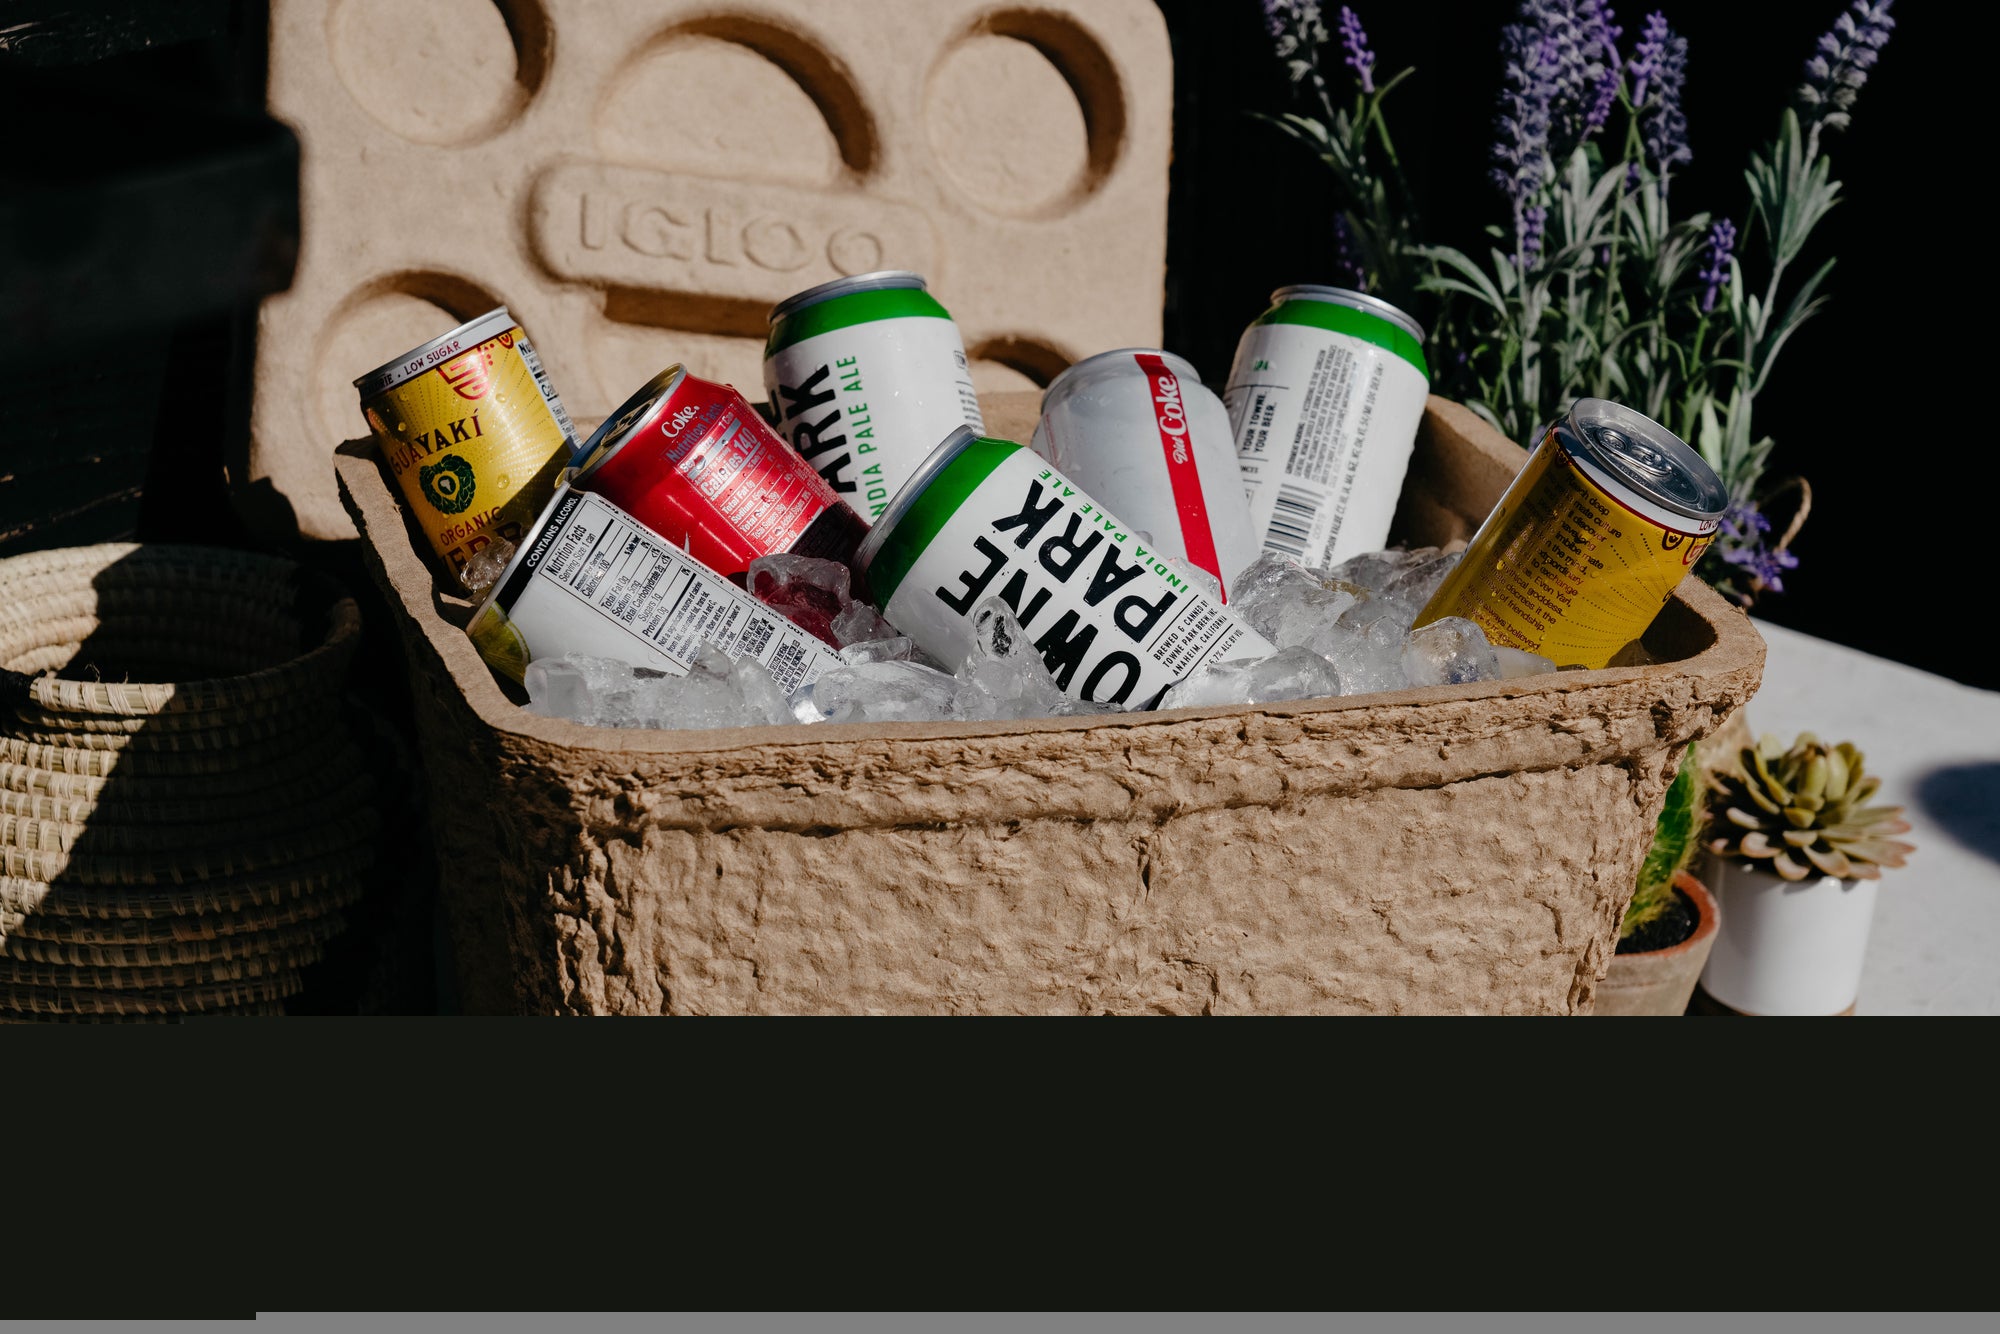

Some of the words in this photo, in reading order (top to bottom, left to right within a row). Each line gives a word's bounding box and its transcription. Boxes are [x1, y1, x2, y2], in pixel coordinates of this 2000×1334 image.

[579, 192, 884, 277] IGLOO
[402, 357, 426, 375] LOW
[426, 341, 460, 363] SUGAR
[836, 356, 863, 392] ALE
[390, 408, 484, 475] GUAYAKÍ
[666, 423, 705, 461] Nutrition
[699, 403, 722, 423] Facts
[778, 363, 857, 492] ARK
[848, 403, 878, 454] PALE
[1242, 428, 1254, 450] YOUR
[1254, 430, 1267, 451] YOUR
[701, 454, 745, 495] Calories
[728, 428, 759, 455] 140
[1173, 436, 1188, 465] Diet
[722, 495, 739, 513] Total
[736, 486, 748, 498] Fat
[862, 463, 889, 527] NDIA
[1038, 468, 1075, 498] ALE
[598, 499, 618, 514] free
[731, 498, 754, 523] Sodium
[740, 514, 757, 531] Total
[761, 511, 780, 528] Sugars
[1079, 502, 1128, 543] PALE
[1571, 498, 1595, 519] mate
[1587, 494, 1613, 517] deep
[440, 506, 504, 547] ORGANIC
[527, 525, 558, 566] CONTAINS
[555, 498, 577, 524] ALCOHOL
[623, 515, 655, 537] gluten
[1571, 513, 1608, 544] discover
[545, 543, 574, 575] Nutrition
[566, 524, 586, 544] Facts
[558, 559, 579, 582] Serving
[573, 547, 586, 560] Size
[585, 533, 595, 543] can
[598, 558, 610, 571] 100
[992, 478, 1178, 644] PARK
[1549, 544, 1566, 559] the
[1553, 530, 1584, 556] imbibe
[1580, 549, 1605, 571] mate
[574, 573, 587, 590] Amount
[589, 551, 605, 565] Serving
[1135, 545, 1189, 593] INDIA
[1529, 558, 1541, 570] to
[1537, 564, 1580, 598] exchange
[1532, 575, 1557, 596] Even
[600, 593, 615, 609] Total
[611, 582, 623, 594] Fat
[618, 574, 631, 586] 0g
[611, 593, 630, 616] Sodium
[627, 580, 642, 593] 5mg
[621, 606, 636, 622] Total
[632, 570, 662, 607] Carbohydrate
[637, 601, 658, 622] Sugars
[651, 592, 663, 602] 1g
[743, 595, 783, 622] calories
[1498, 590, 1511, 604] of
[1503, 581, 1538, 610] decrees
[1534, 604, 1544, 615] it
[1541, 608, 1559, 626] the
[642, 614, 661, 637] Protein
[656, 604, 669, 616] 0g
[787, 624, 803, 636] 100
[934, 535, 1172, 712] OWNE
[1153, 633, 1178, 660] BREWED
[1183, 605, 1203, 625] CANNED
[1504, 596, 1551, 634] friendship.
[657, 636, 667, 646] Not
[1162, 644, 1183, 667] TOWNE
[1181, 628, 1198, 645] PARK
[1195, 615, 1211, 630] BREW,
[1172, 644, 1202, 675] ANAHEIM,
[1200, 615, 1226, 642] CALIFORNIA
[1221, 640, 1231, 652] ALC
[1228, 635, 1236, 643] BY
[1504, 621, 1542, 652] believed
